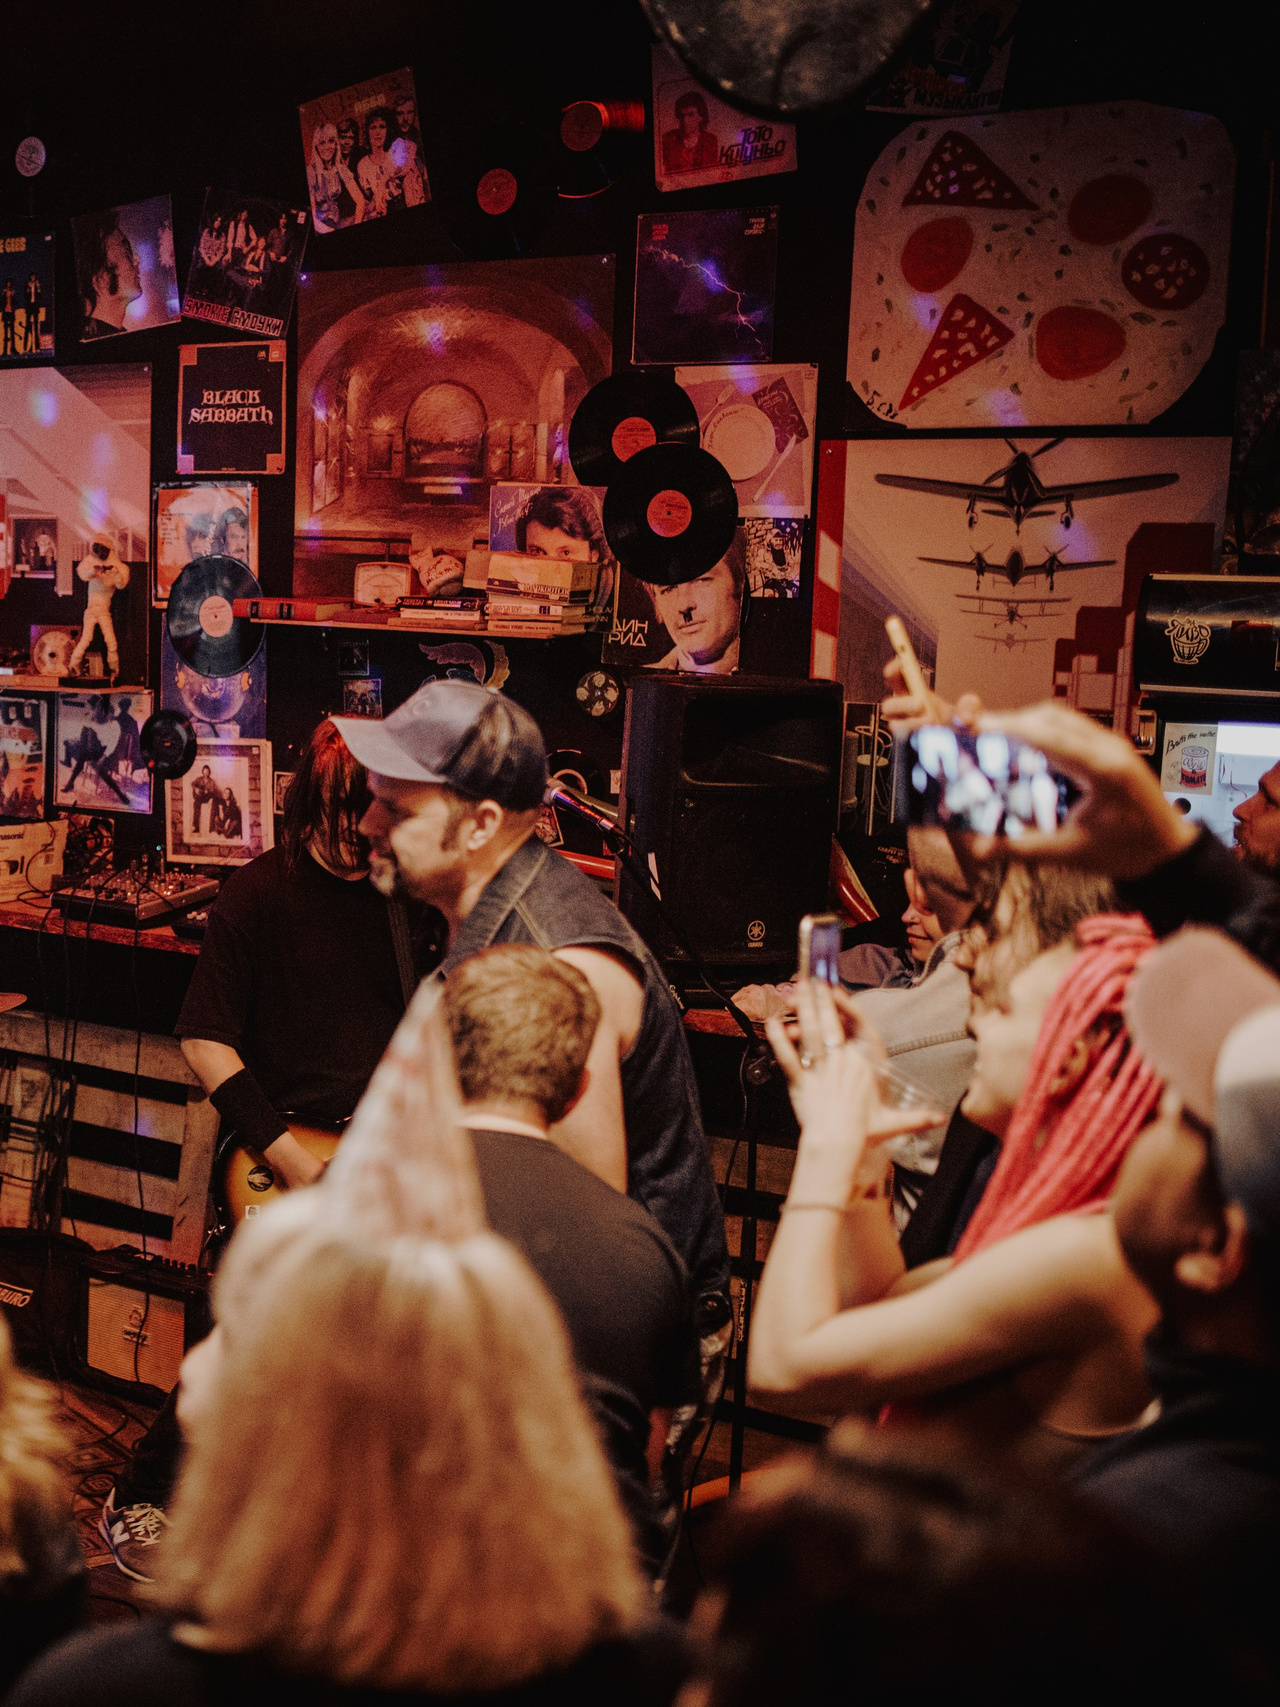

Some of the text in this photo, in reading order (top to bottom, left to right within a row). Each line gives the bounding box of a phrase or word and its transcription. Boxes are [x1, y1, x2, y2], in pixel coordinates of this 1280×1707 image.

[201, 388, 261, 406] BLACK
[188, 406, 273, 425] SABBATH
[608, 631, 648, 647] РИД
